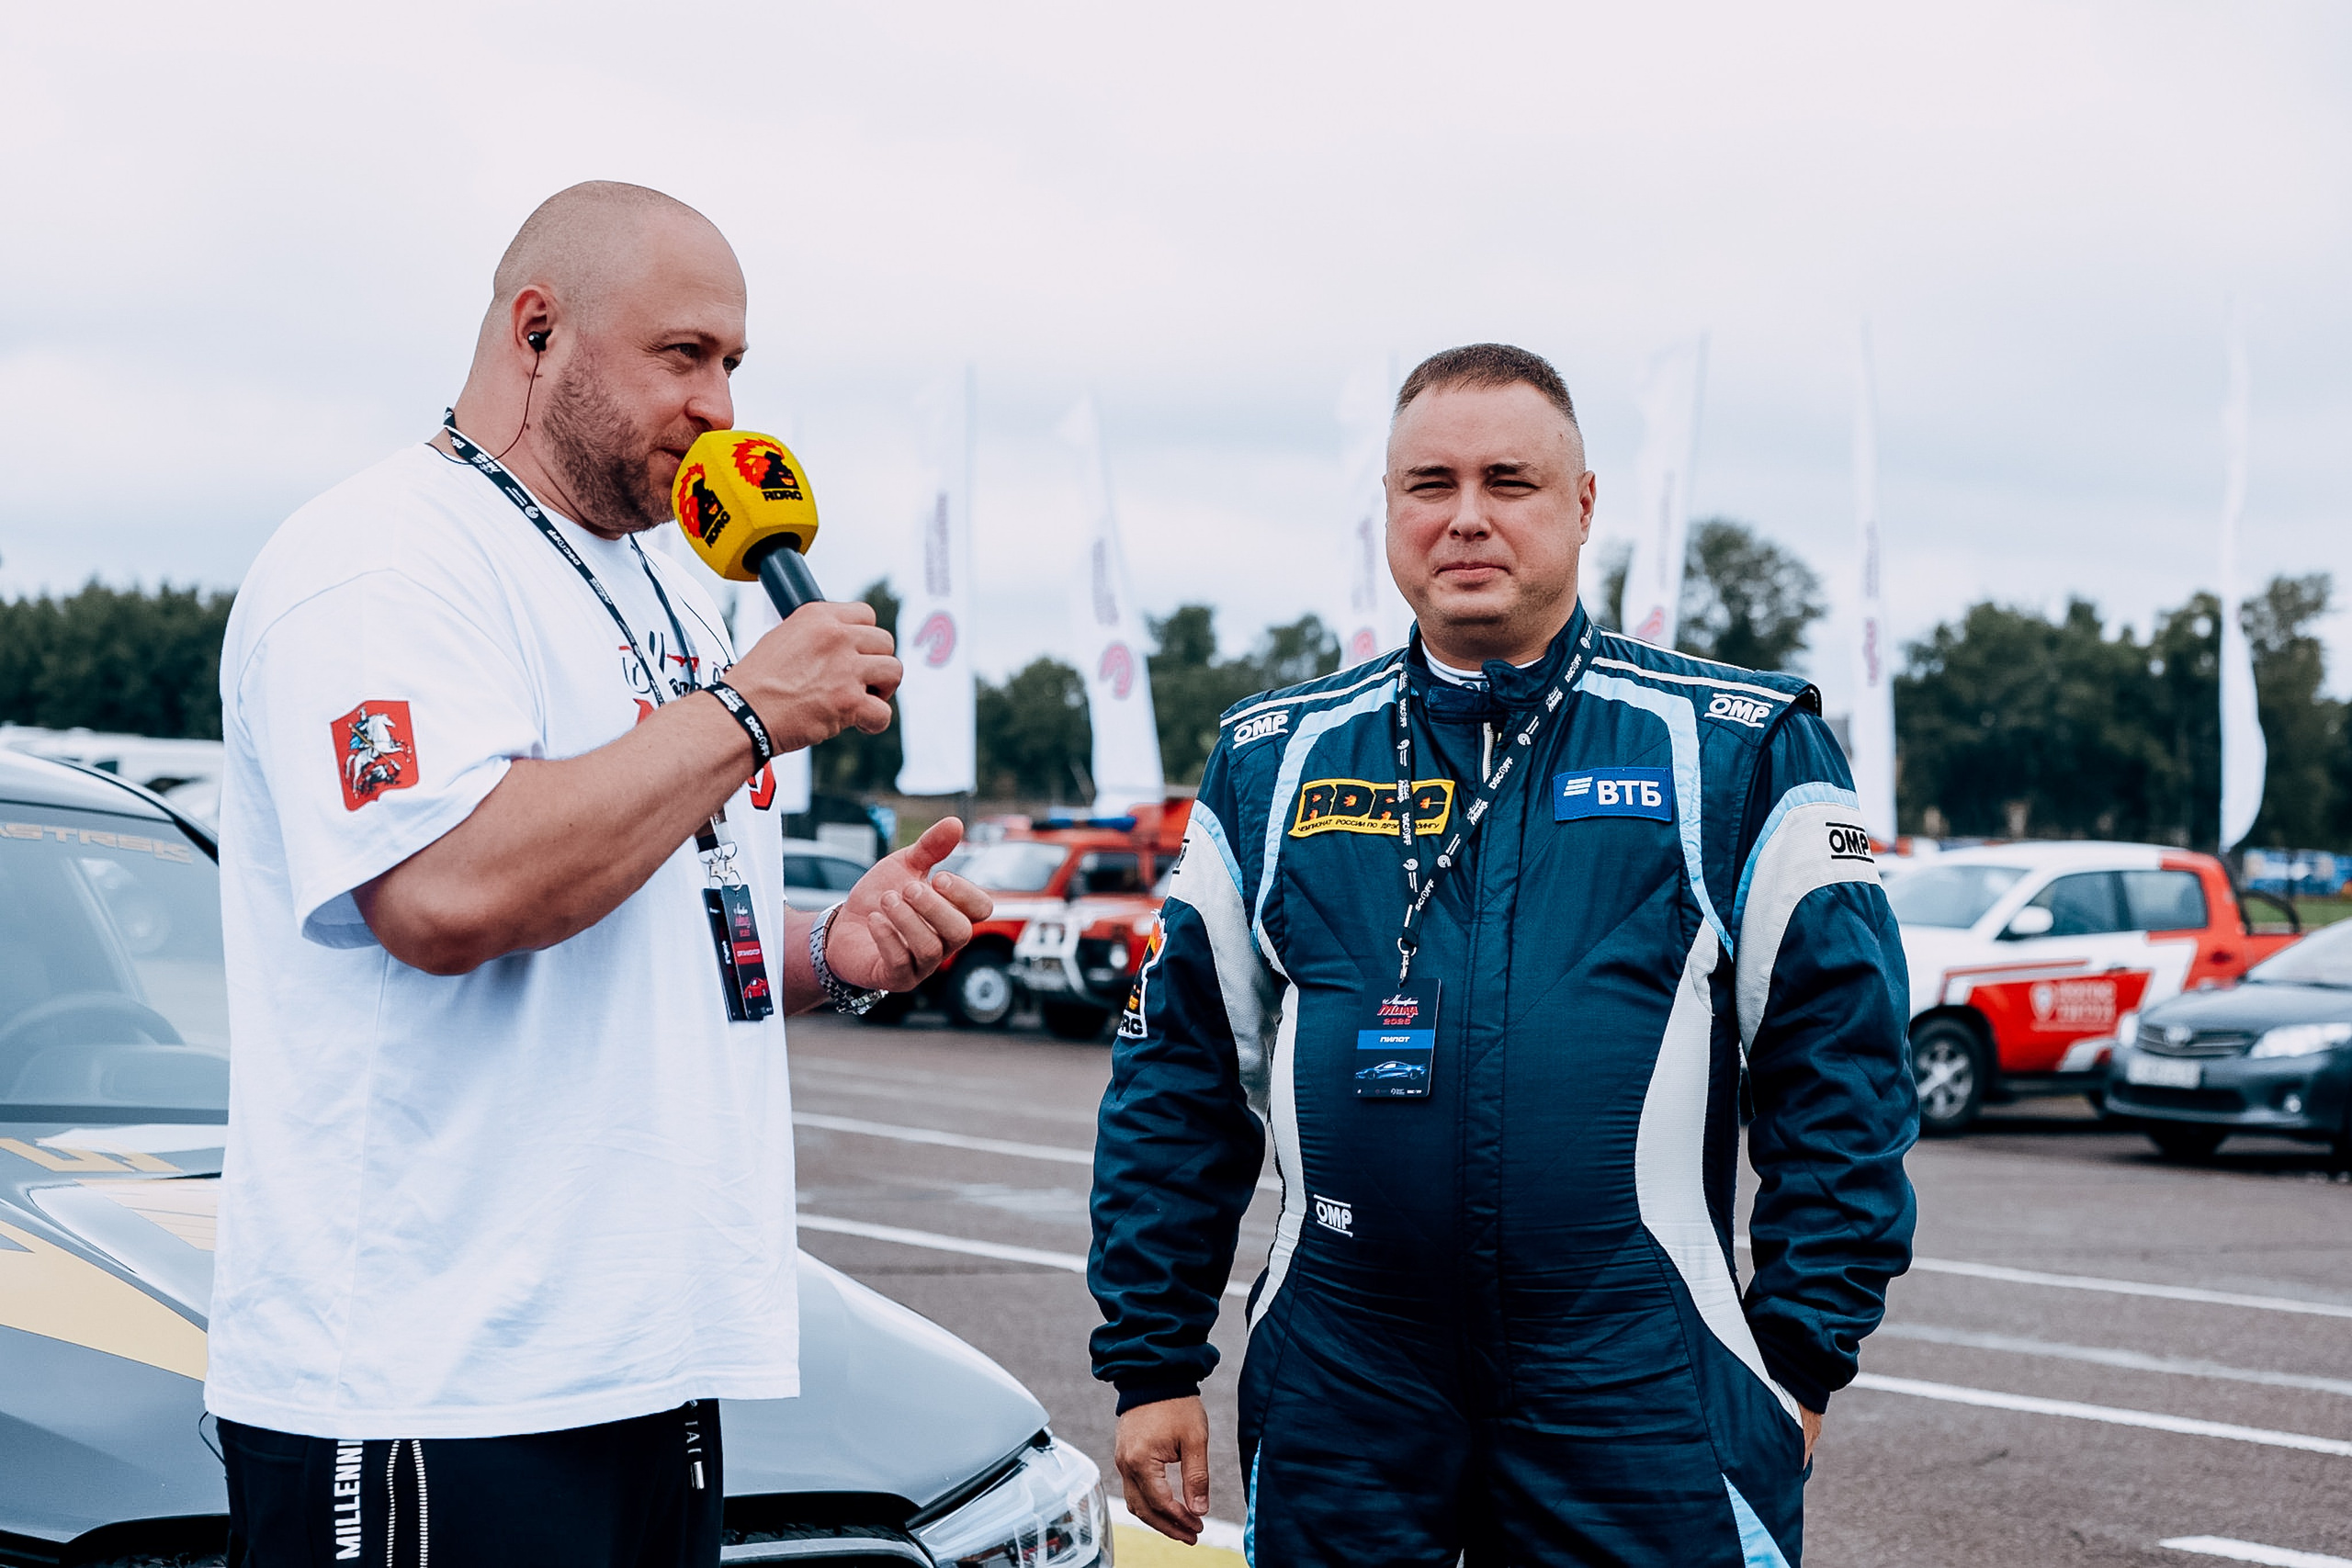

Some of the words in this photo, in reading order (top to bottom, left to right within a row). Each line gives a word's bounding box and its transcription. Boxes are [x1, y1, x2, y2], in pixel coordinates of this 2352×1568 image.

[1708, 697, 1770, 724] OMP
[1234, 714, 1289, 743] OMP
[1597, 780, 1663, 807] ВТБ
[1828, 829, 1870, 856] OMP
[1415, 878, 1435, 912] SCOFF
[1379, 1035, 1411, 1043] ПИЛОТ
[1316, 1201, 1353, 1230] OMP
